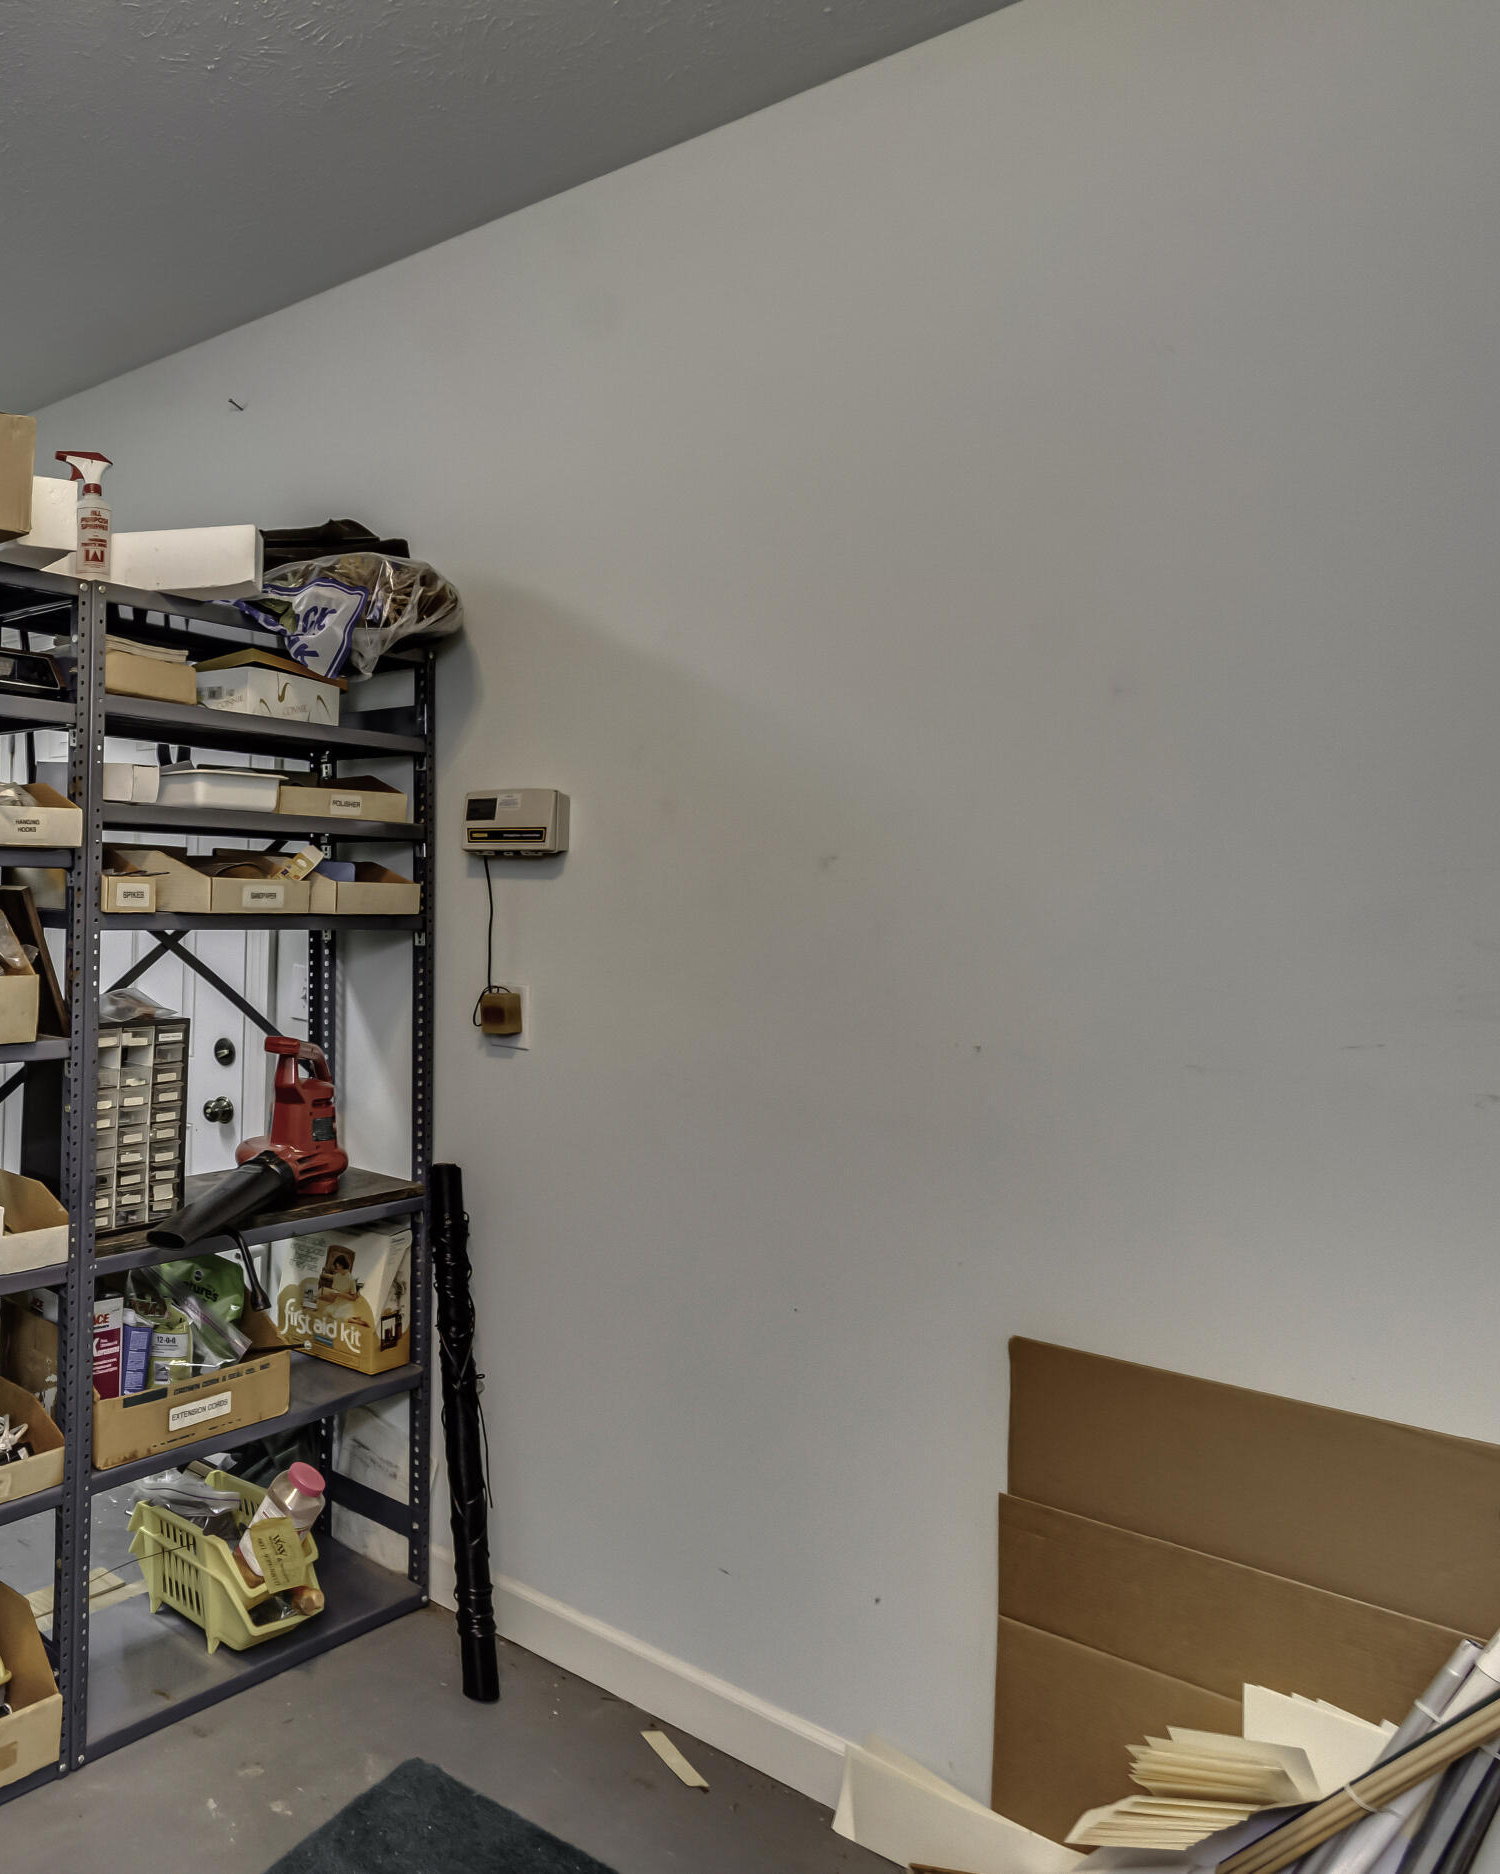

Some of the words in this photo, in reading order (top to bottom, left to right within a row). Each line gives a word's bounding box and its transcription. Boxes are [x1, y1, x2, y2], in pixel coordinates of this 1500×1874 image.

[332, 800, 361, 809] POLISHER
[122, 891, 145, 899] SPIKES
[280, 1298, 312, 1335] first
[313, 1316, 337, 1339] aid
[340, 1322, 361, 1353] kit
[171, 1406, 206, 1421] EXTENSION
[207, 1399, 229, 1411] CORDS
